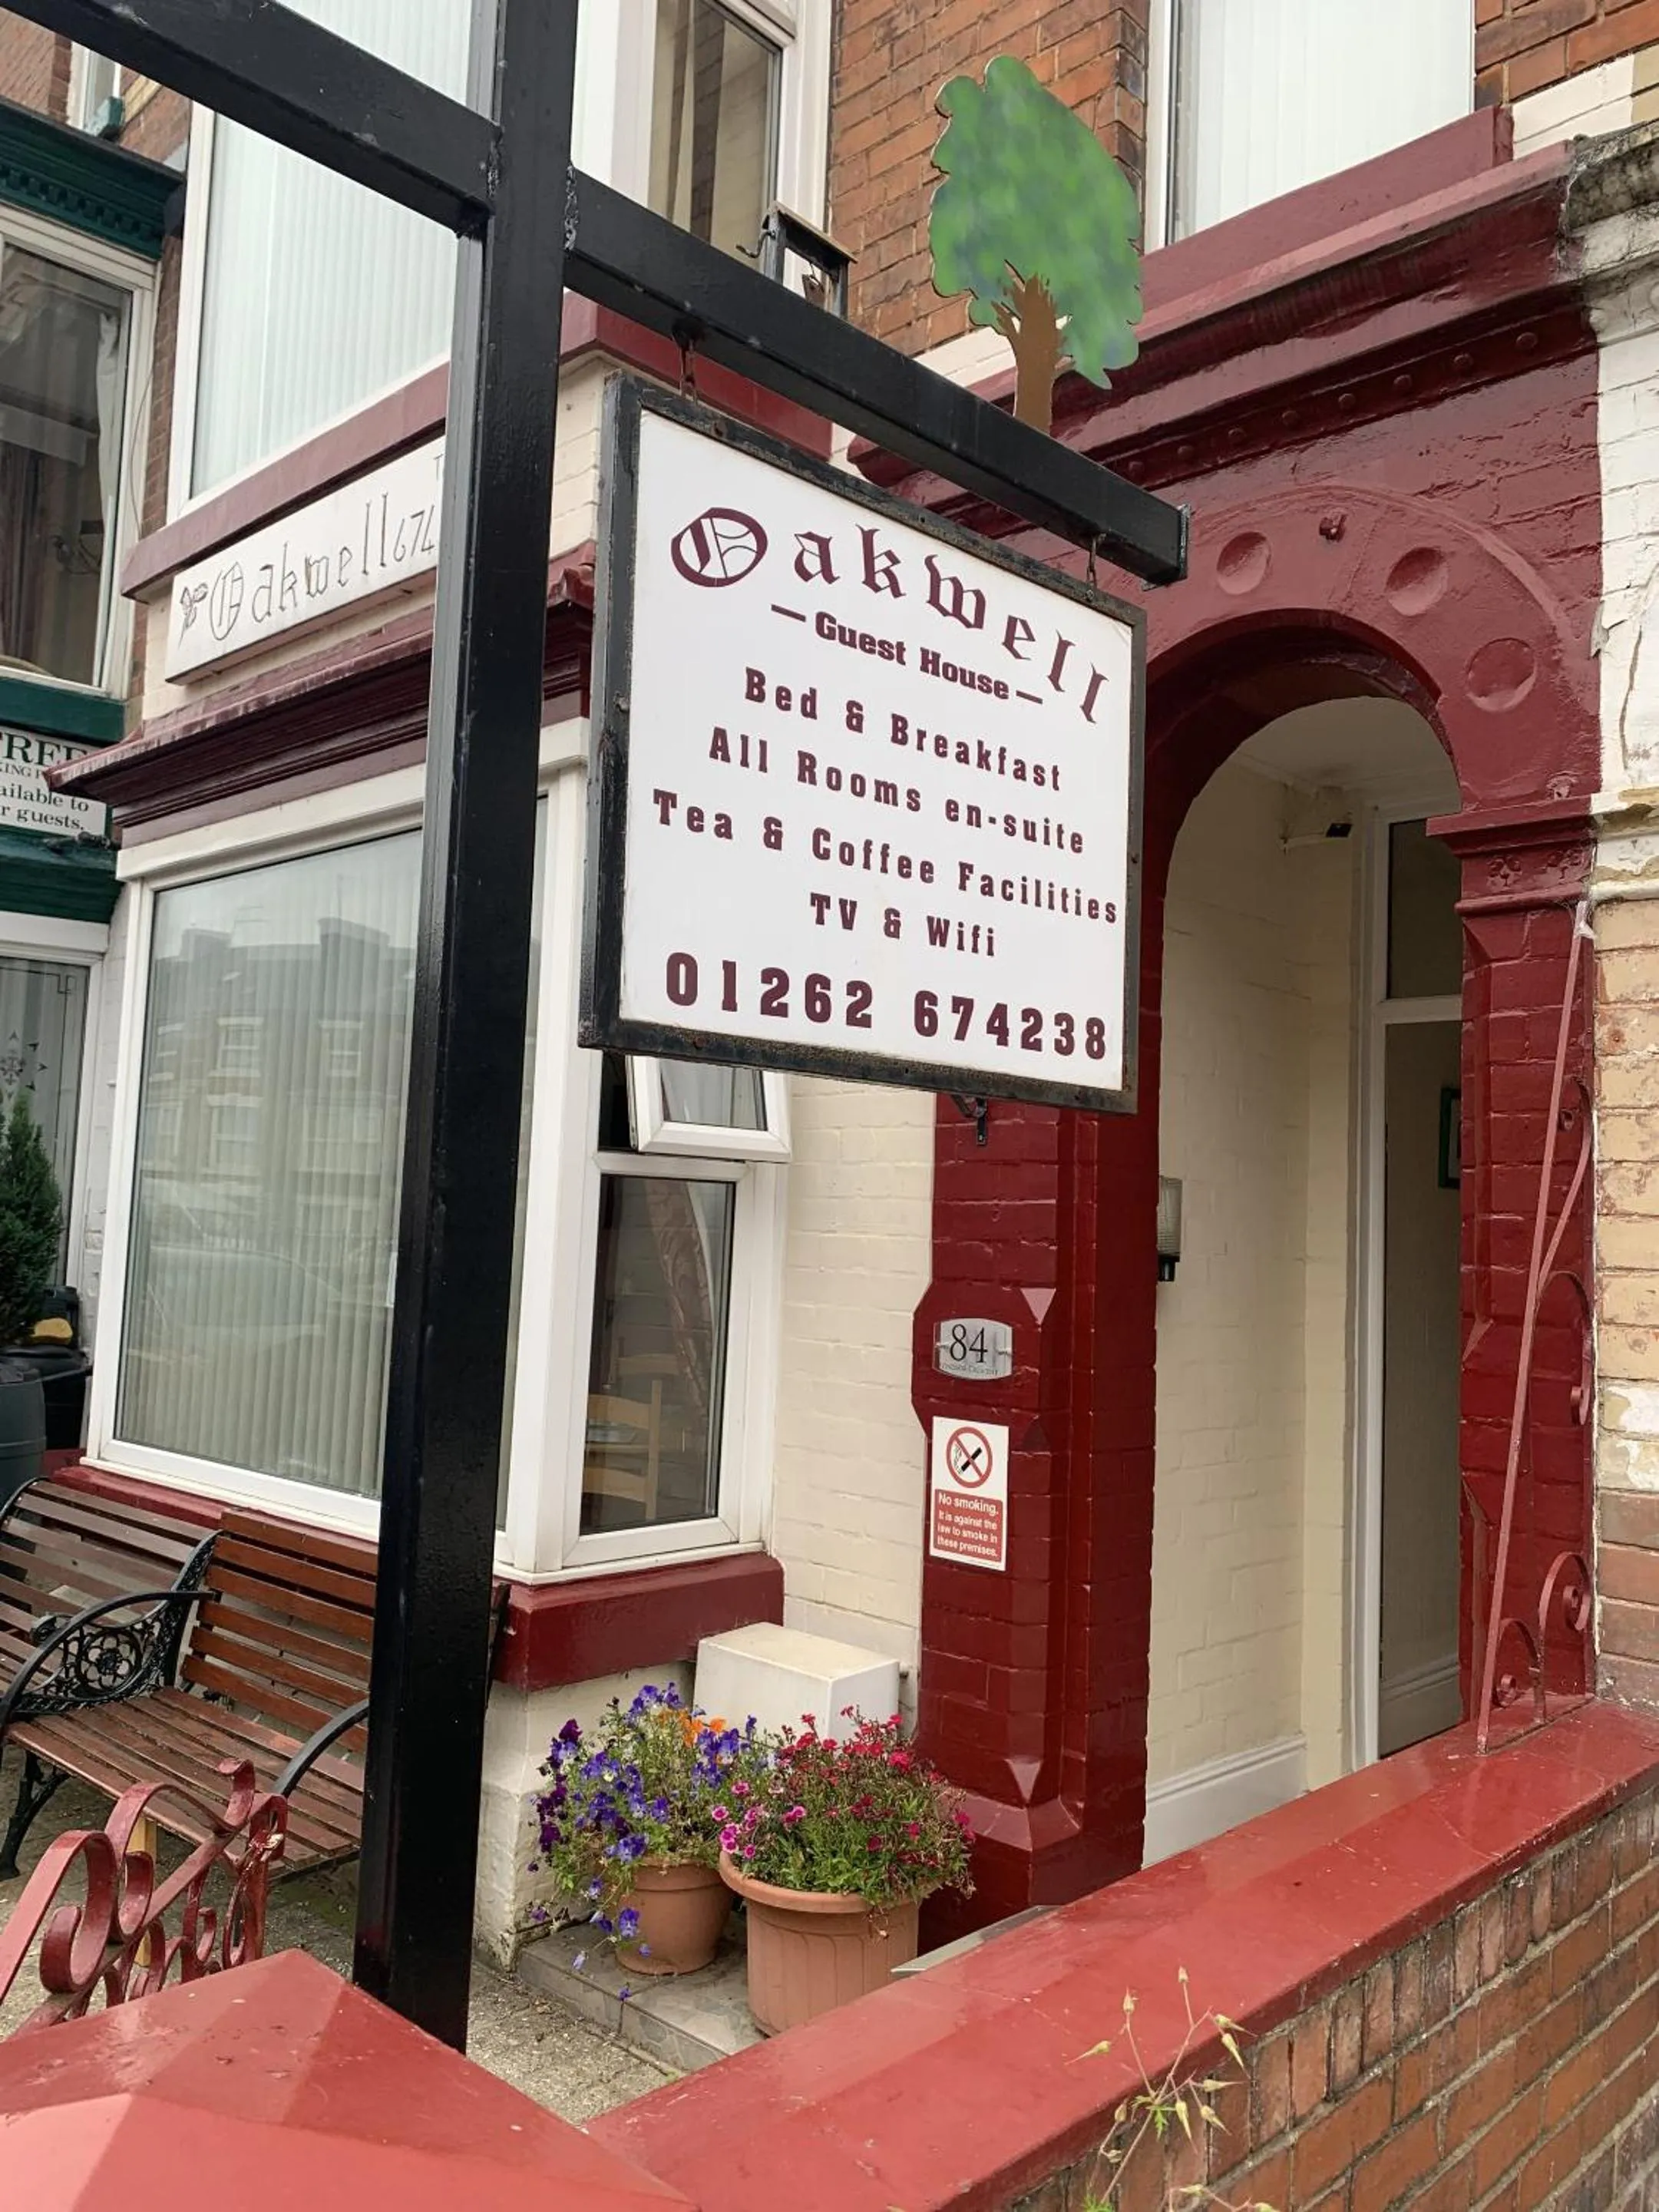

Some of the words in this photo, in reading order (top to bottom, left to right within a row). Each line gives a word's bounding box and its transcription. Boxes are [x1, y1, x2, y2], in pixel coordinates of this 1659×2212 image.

[208, 493, 388, 641] Oakwell
[670, 507, 1109, 724] Oakwell
[815, 611, 907, 666] Guest
[920, 646, 1010, 700] House
[745, 666, 818, 720] Bed
[845, 700, 864, 734] &
[891, 713, 1061, 792] Breakfast
[17, 809, 84, 830] guests.
[71, 797, 89, 812] to
[708, 726, 768, 774] All
[797, 749, 921, 812] Rooms
[944, 798, 1084, 855] en-suite
[653, 789, 734, 840] Tea
[763, 816, 783, 851] &
[812, 828, 935, 884] Coffee
[958, 861, 1117, 924] Facilities
[810, 892, 858, 931] TV
[884, 908, 901, 940] &
[927, 915, 995, 957] Wifi
[666, 952, 874, 1029] 01262
[914, 990, 1106, 1060] 674238
[949, 1323, 989, 1364] 84
[937, 1523, 951, 1533] law
[952, 1526, 961, 1536] to
[961, 1529, 989, 1541] smoke
[990, 1533, 998, 1543] in
[938, 1492, 952, 1506] No
[953, 1496, 999, 1516] smoking.
[938, 1509, 945, 1520] It
[945, 1510, 953, 1521] is
[953, 1514, 983, 1529] against
[984, 1519, 998, 1530] the
[937, 1535, 958, 1549] these
[959, 1541, 998, 1556] premises.
